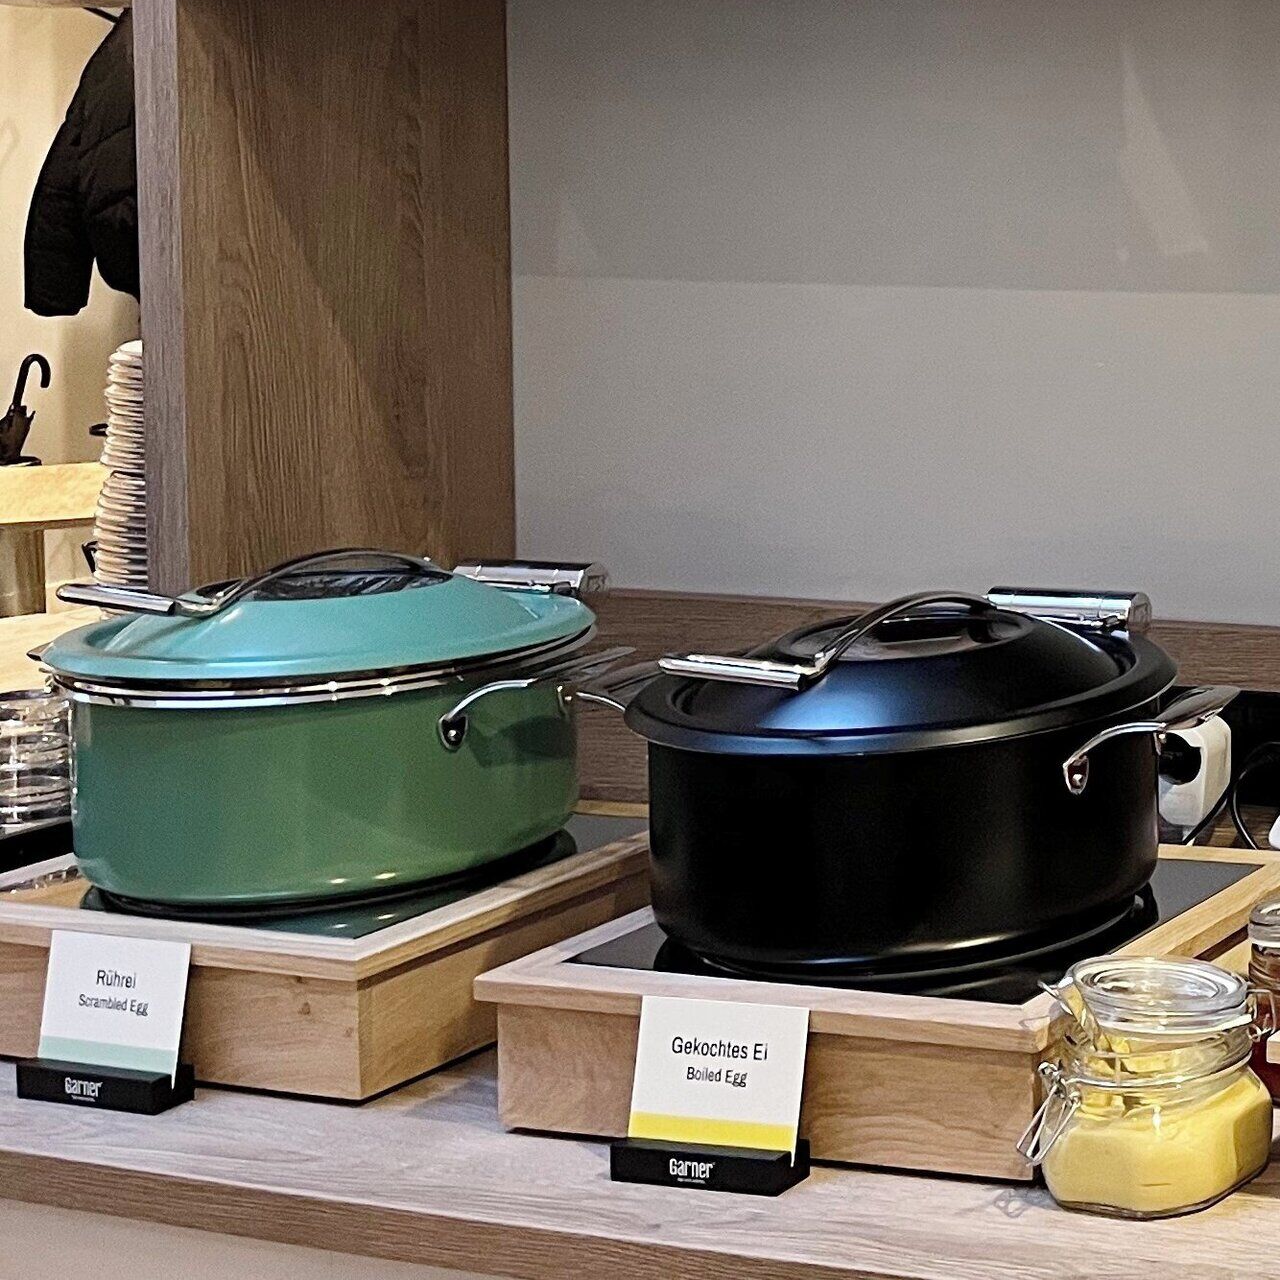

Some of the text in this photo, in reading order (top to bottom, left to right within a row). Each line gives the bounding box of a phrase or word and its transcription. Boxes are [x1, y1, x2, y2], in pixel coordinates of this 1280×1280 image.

[96, 969, 137, 989] Rührei
[79, 993, 149, 1017] Scrambled Egg
[672, 1036, 768, 1060] Gekochtes Ei
[65, 1076, 101, 1097] Garner
[686, 1066, 748, 1088] Boiled Egg
[669, 1158, 714, 1179] Garner
